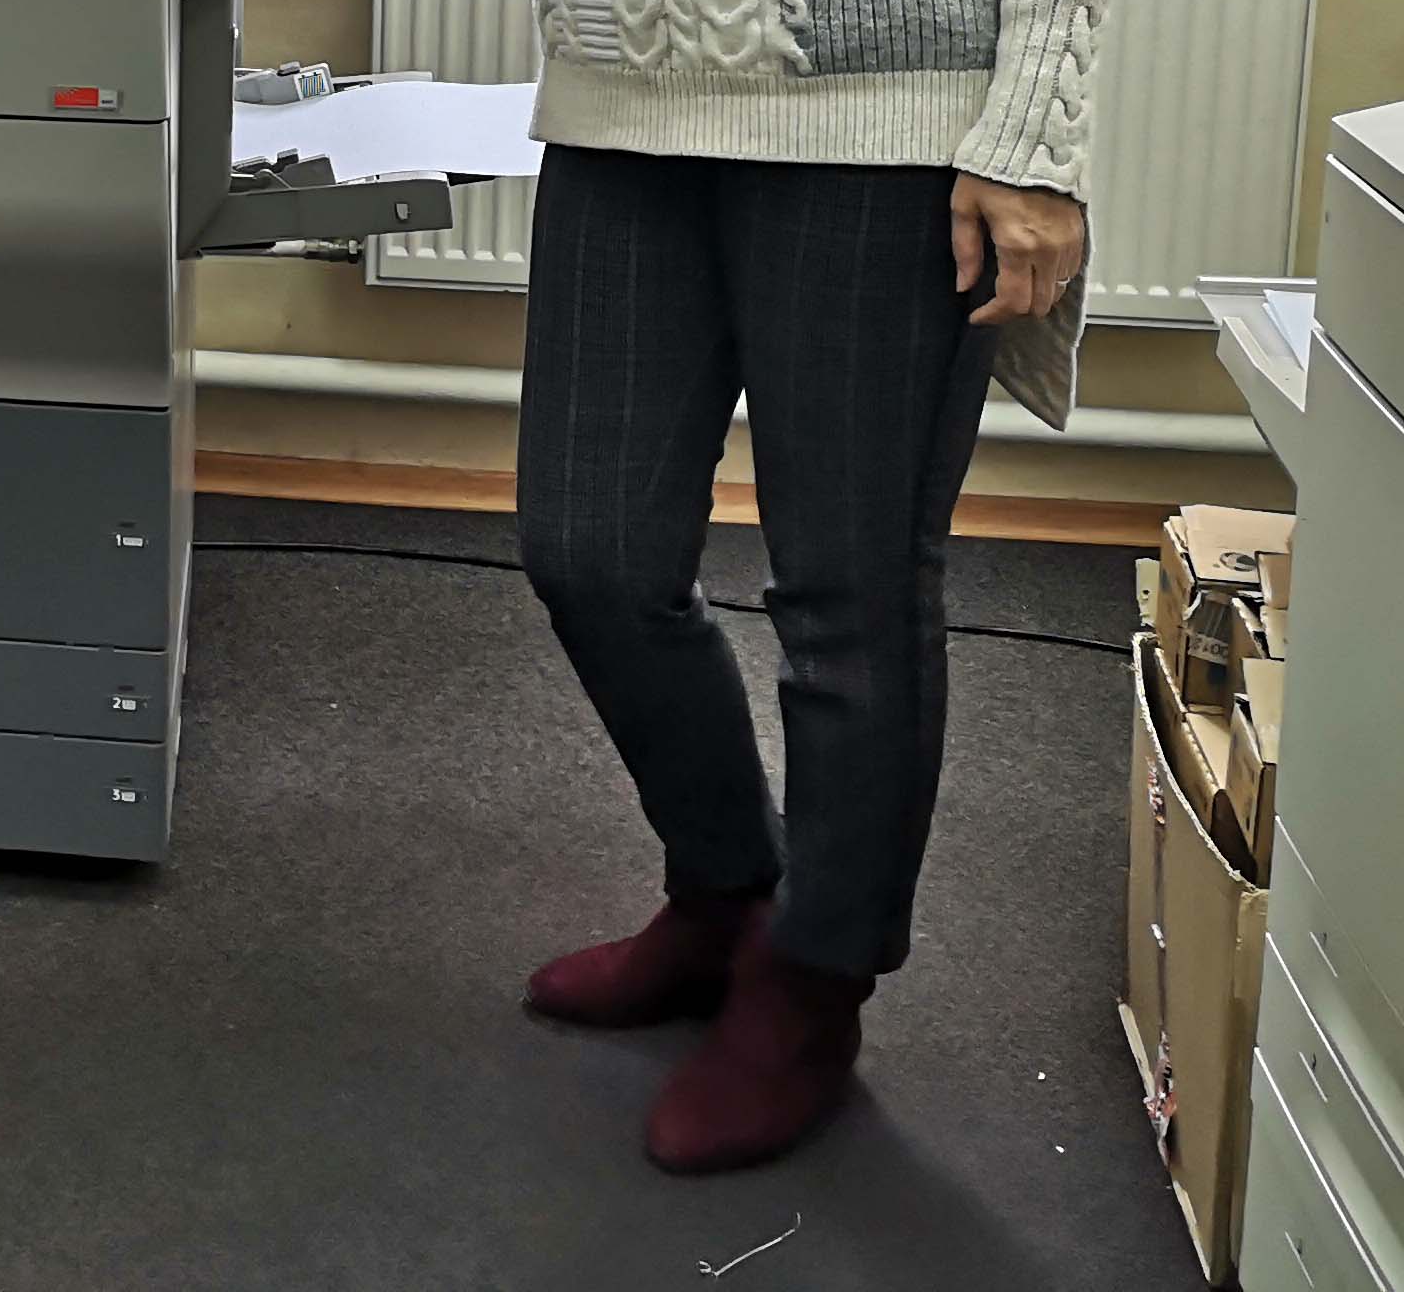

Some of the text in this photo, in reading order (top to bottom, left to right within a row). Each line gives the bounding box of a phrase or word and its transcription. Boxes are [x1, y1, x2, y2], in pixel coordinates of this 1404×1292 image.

[115, 534, 121, 546] 1
[112, 697, 121, 709] 2
[112, 788, 121, 801] 3
